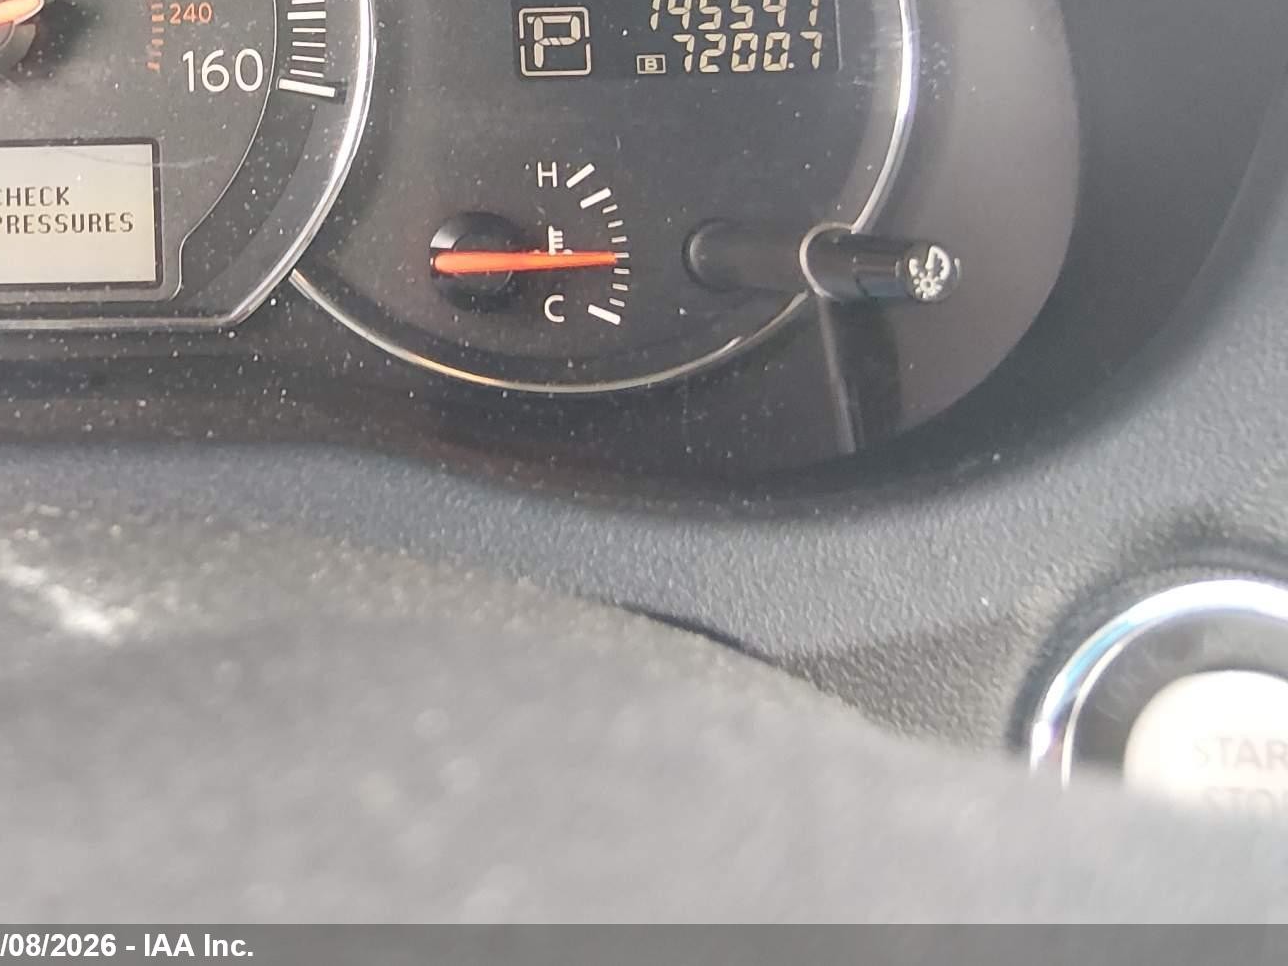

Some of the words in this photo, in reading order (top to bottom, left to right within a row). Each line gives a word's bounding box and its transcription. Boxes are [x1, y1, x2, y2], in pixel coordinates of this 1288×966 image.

[170, 3, 212, 24] 240
[526, 15, 581, 68] P
[672, 32, 822, 73] 7200.7
[182, 50, 264, 92] 160
[536, 161, 558, 187] H
[543, 294, 565, 322] C
